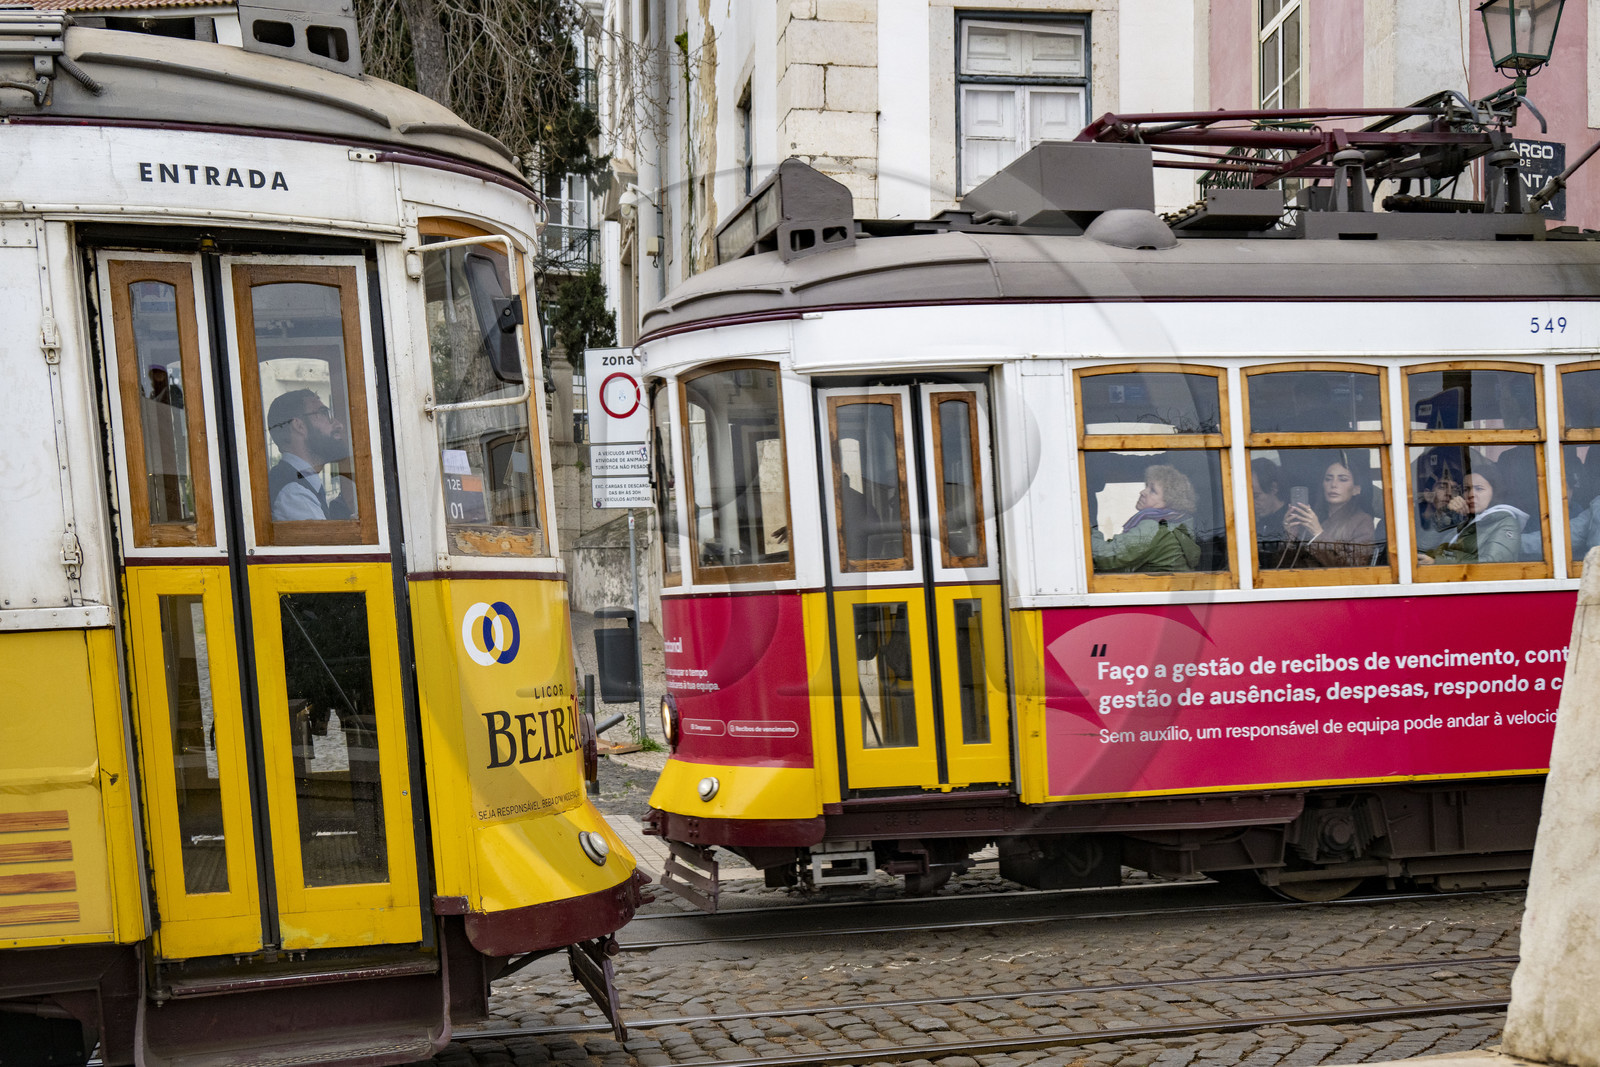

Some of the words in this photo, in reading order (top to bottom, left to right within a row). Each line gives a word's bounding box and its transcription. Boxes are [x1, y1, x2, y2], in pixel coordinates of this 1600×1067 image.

[1509, 142, 1554, 159] ARGO
[1520, 158, 1531, 167] DE
[139, 162, 289, 191] ENTRADA
[1530, 317, 1567, 334] 549
[602, 355, 634, 366] zona
[446, 479, 462, 491] 12E
[450, 502, 465, 519] 01
[1097, 661, 1149, 686] Faço
[1154, 664, 1167, 678] a
[1172, 657, 1244, 683] gestão
[1249, 656, 1277, 675] de
[1281, 653, 1359, 674] recibos
[1364, 651, 1391, 671] de
[1394, 648, 1520, 670] vencimento,
[1525, 646, 1570, 664] cont
[534, 684, 564, 699] LICOR
[1098, 688, 1172, 715] gestão
[1177, 688, 1205, 707] de
[1209, 683, 1322, 705] ausências,
[1326, 681, 1429, 704] despesas,
[1434, 674, 1530, 699] respondo
[1534, 677, 1546, 692] a
[1550, 676, 1563, 690] c
[735, 725, 755, 733] Recibos
[1099, 728, 1135, 744] Sem
[1140, 724, 1193, 743] auxílio,
[1197, 726, 1222, 740] um
[1226, 719, 1319, 742] responsável
[1322, 719, 1343, 734] de
[1347, 717, 1400, 736] equipa
[1404, 714, 1443, 734] pode
[1447, 713, 1490, 728] andar
[1493, 711, 1503, 726] à
[1506, 709, 1559, 725] velocid
[478, 809, 497, 821] SEJA
[542, 797, 555, 808] BEBA
